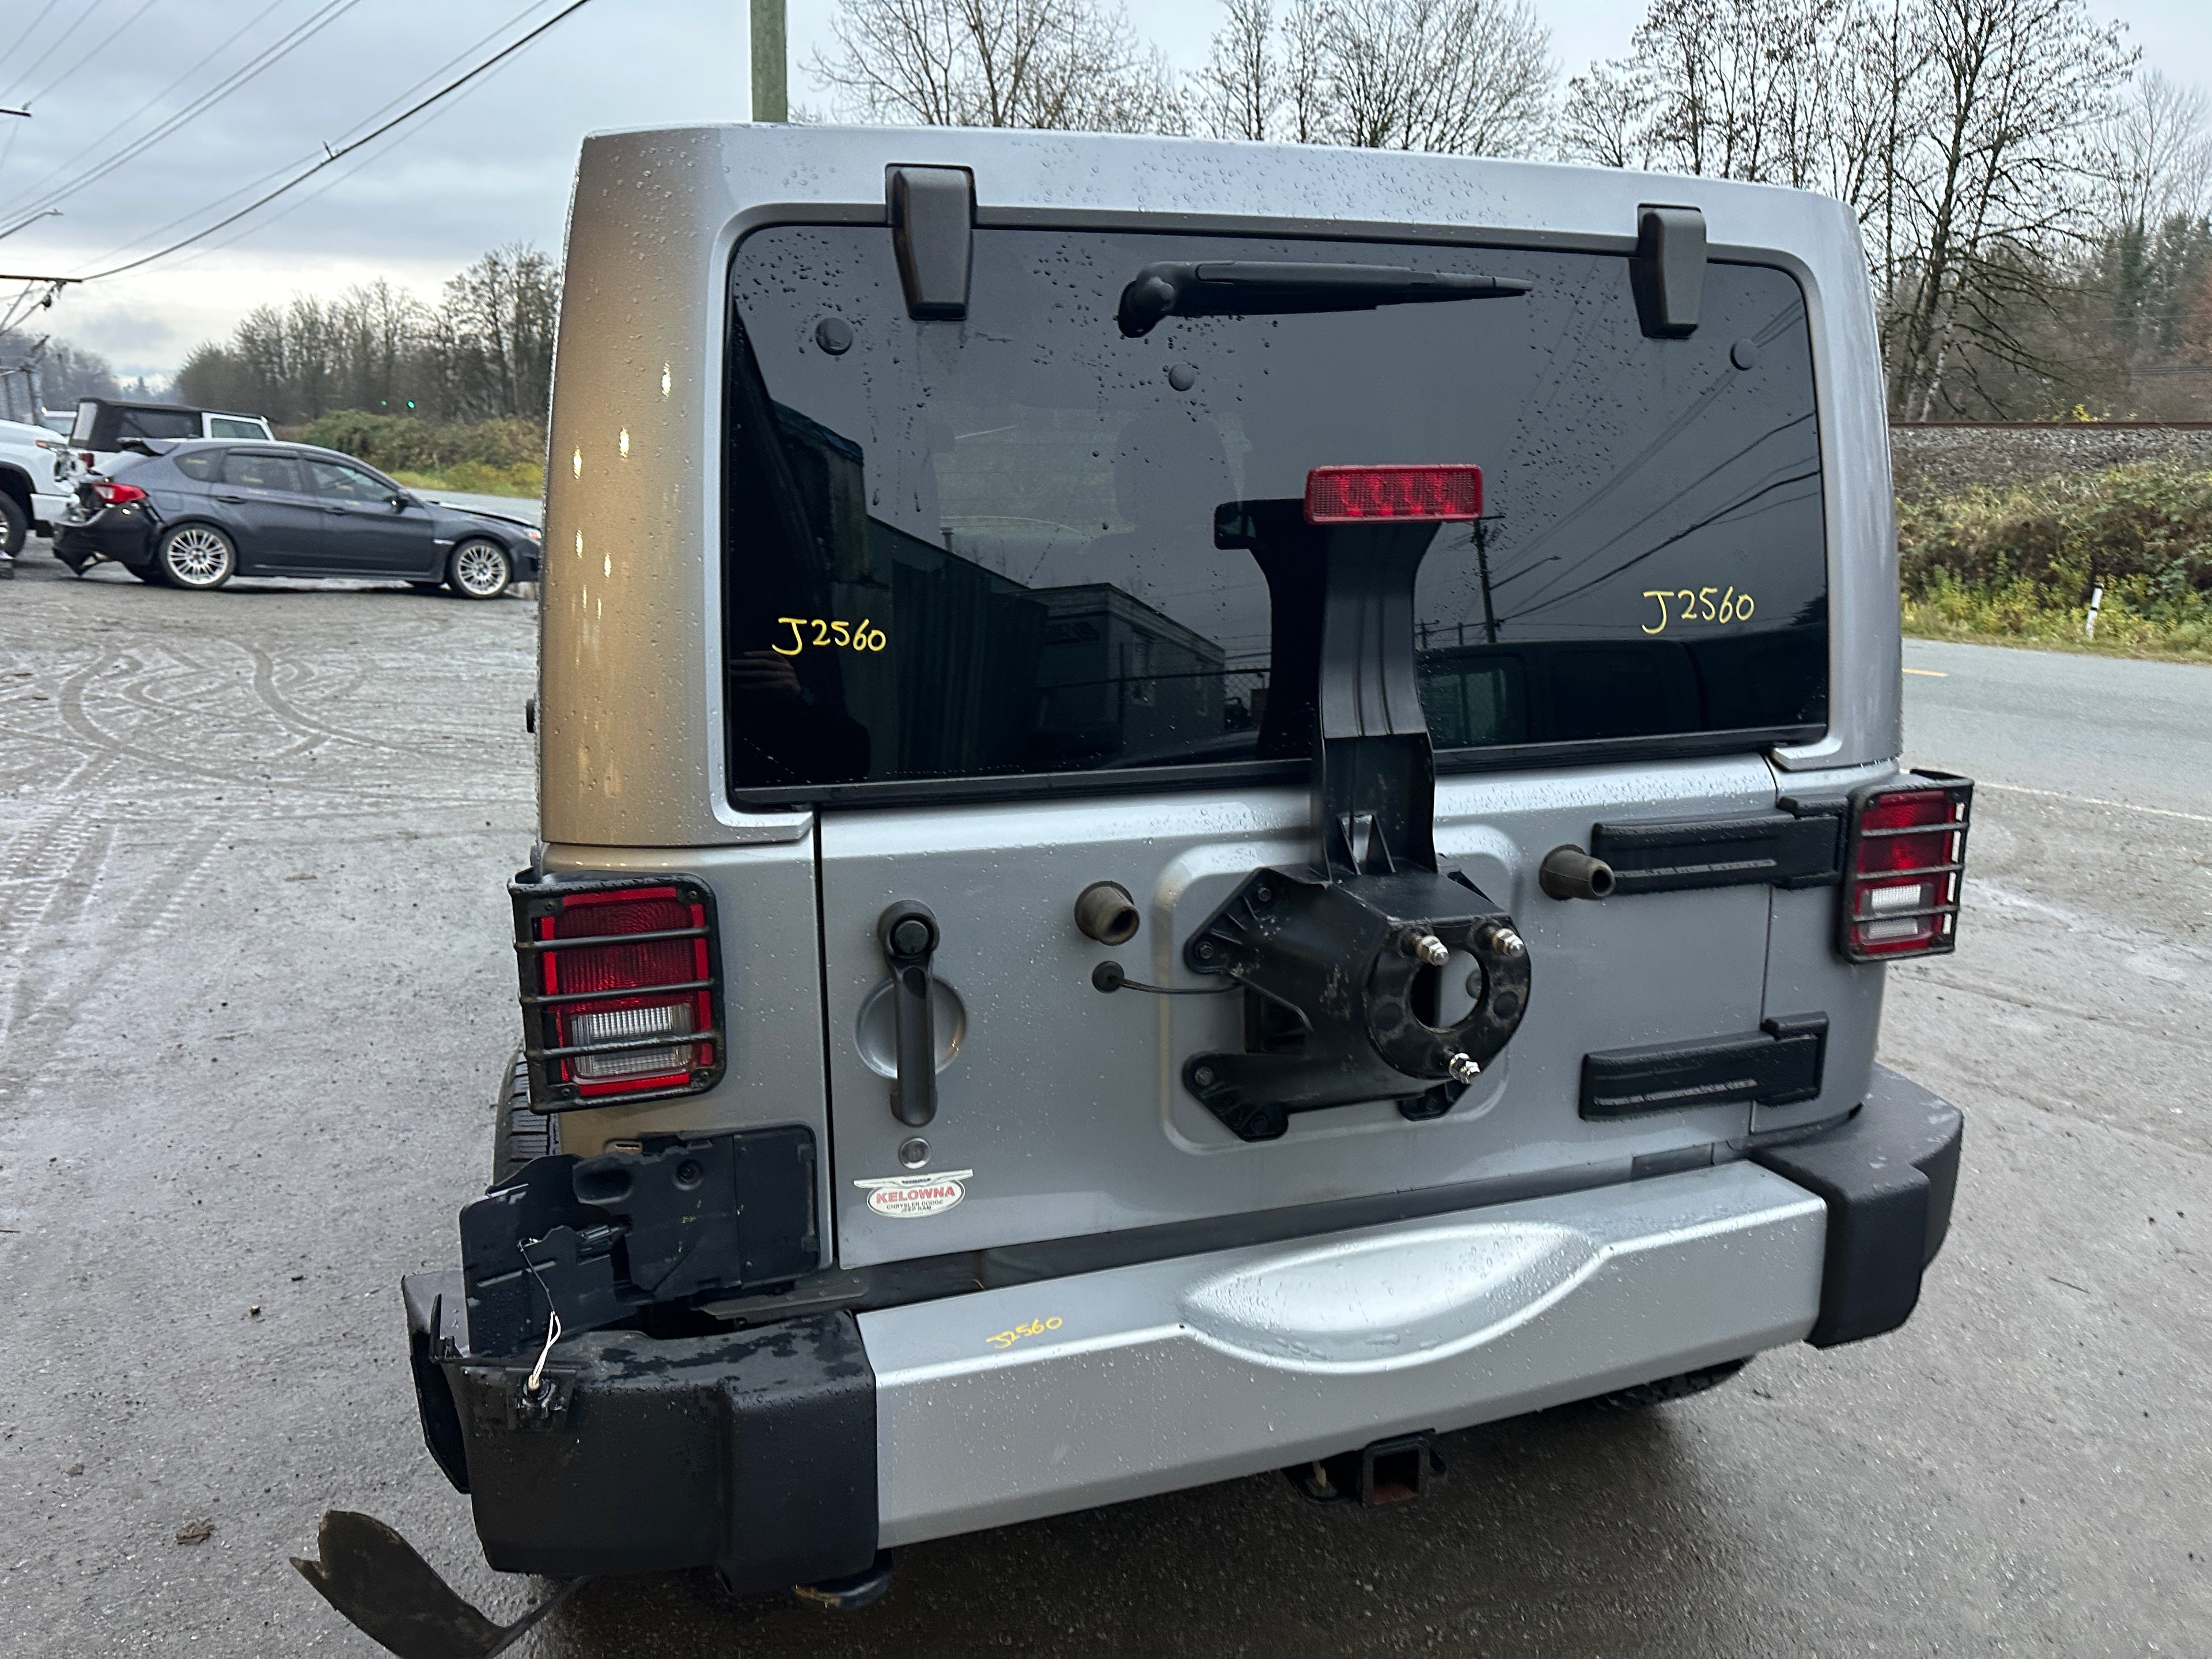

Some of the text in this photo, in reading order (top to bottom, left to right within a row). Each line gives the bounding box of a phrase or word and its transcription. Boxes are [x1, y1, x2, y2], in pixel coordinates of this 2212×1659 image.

[1642, 585, 1754, 634] J2560
[772, 617, 886, 656] J2560
[876, 1186, 955, 1204] KELOWNA
